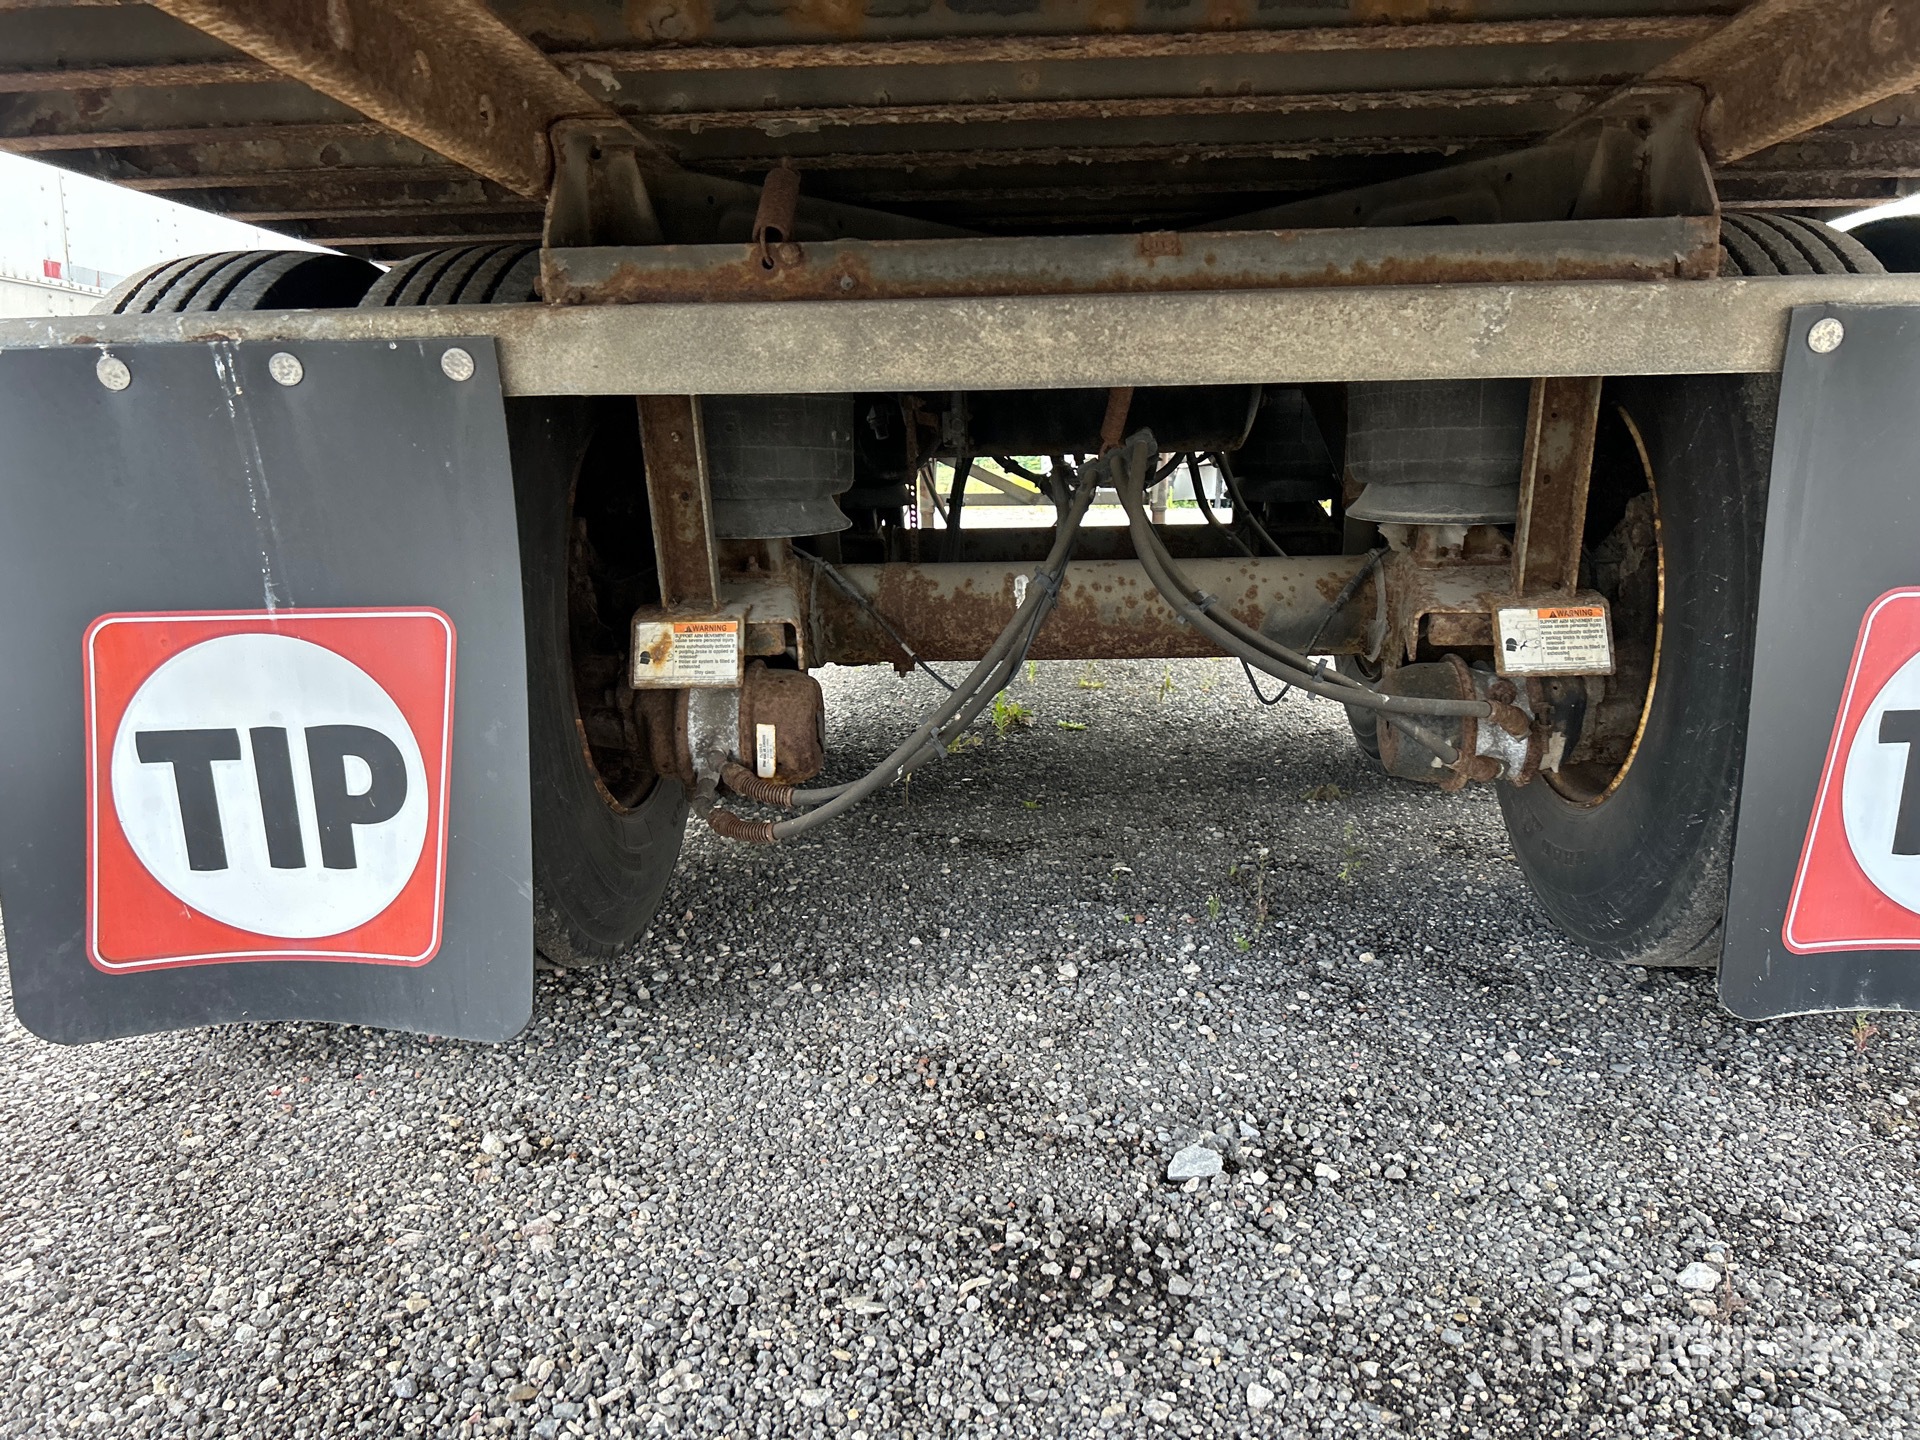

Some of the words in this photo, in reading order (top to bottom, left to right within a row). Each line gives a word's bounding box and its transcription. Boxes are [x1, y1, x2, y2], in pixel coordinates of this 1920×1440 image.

[1556, 609, 1593, 617] WARNING
[693, 624, 727, 632] WARNING
[135, 724, 408, 872] TIP
